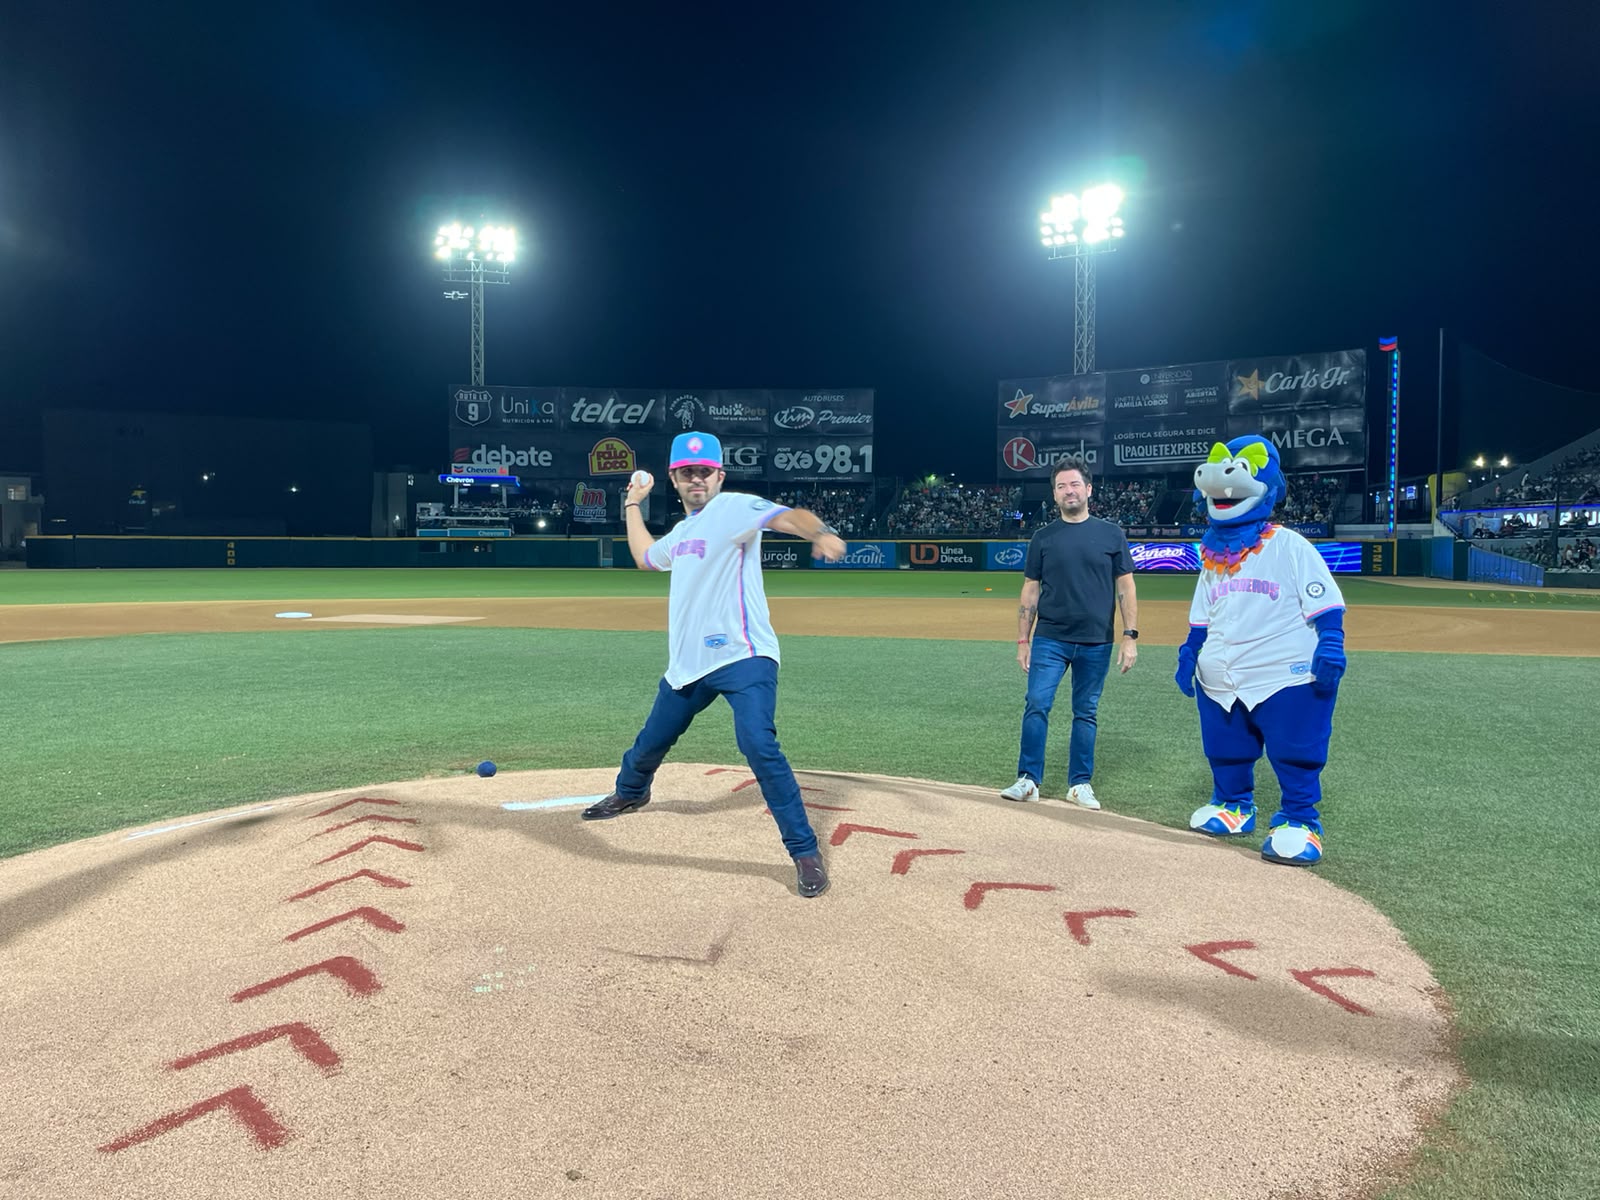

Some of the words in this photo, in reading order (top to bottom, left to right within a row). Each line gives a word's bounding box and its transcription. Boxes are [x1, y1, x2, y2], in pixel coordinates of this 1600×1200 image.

[1265, 369, 1320, 394] Carl's
[1321, 366, 1350, 389] Jr.
[468, 403, 479, 421] 9
[571, 397, 656, 424] telcel
[1114, 400, 1143, 409] FAMILIA
[1144, 399, 1168, 407] LOBOS
[817, 409, 873, 425] Premier
[1153, 430, 1184, 438] SEGURA
[472, 444, 553, 467] debate
[596, 450, 628, 461] POLLO
[1125, 442, 1209, 458] PAQUETEXPRESS
[598, 460, 628, 471] LOCO
[814, 444, 873, 474] 98.1
[760, 547, 797, 562] uroda
[940, 555, 973, 563] Directa
